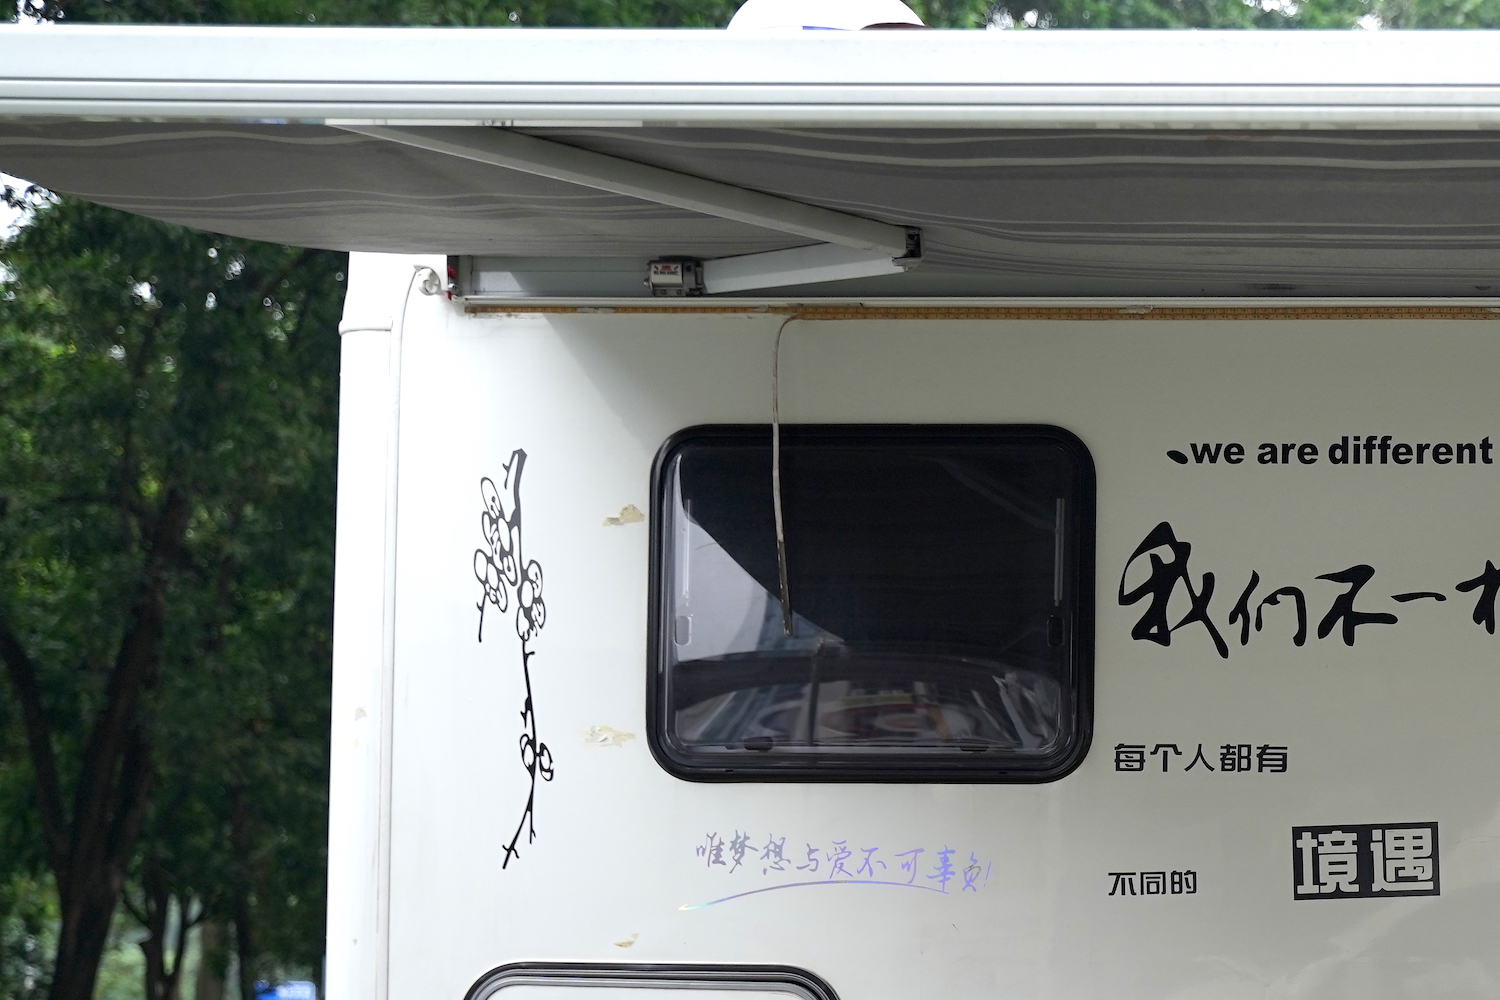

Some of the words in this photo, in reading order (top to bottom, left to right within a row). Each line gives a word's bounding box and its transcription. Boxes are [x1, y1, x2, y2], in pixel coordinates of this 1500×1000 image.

[1190, 443, 1245, 464] we
[1257, 443, 1318, 464] are
[1329, 436, 1493, 464] different
[1114, 743, 1288, 773] 每个人都有
[1292, 822, 1440, 900] 境遇
[1108, 870, 1197, 896] 不同的
